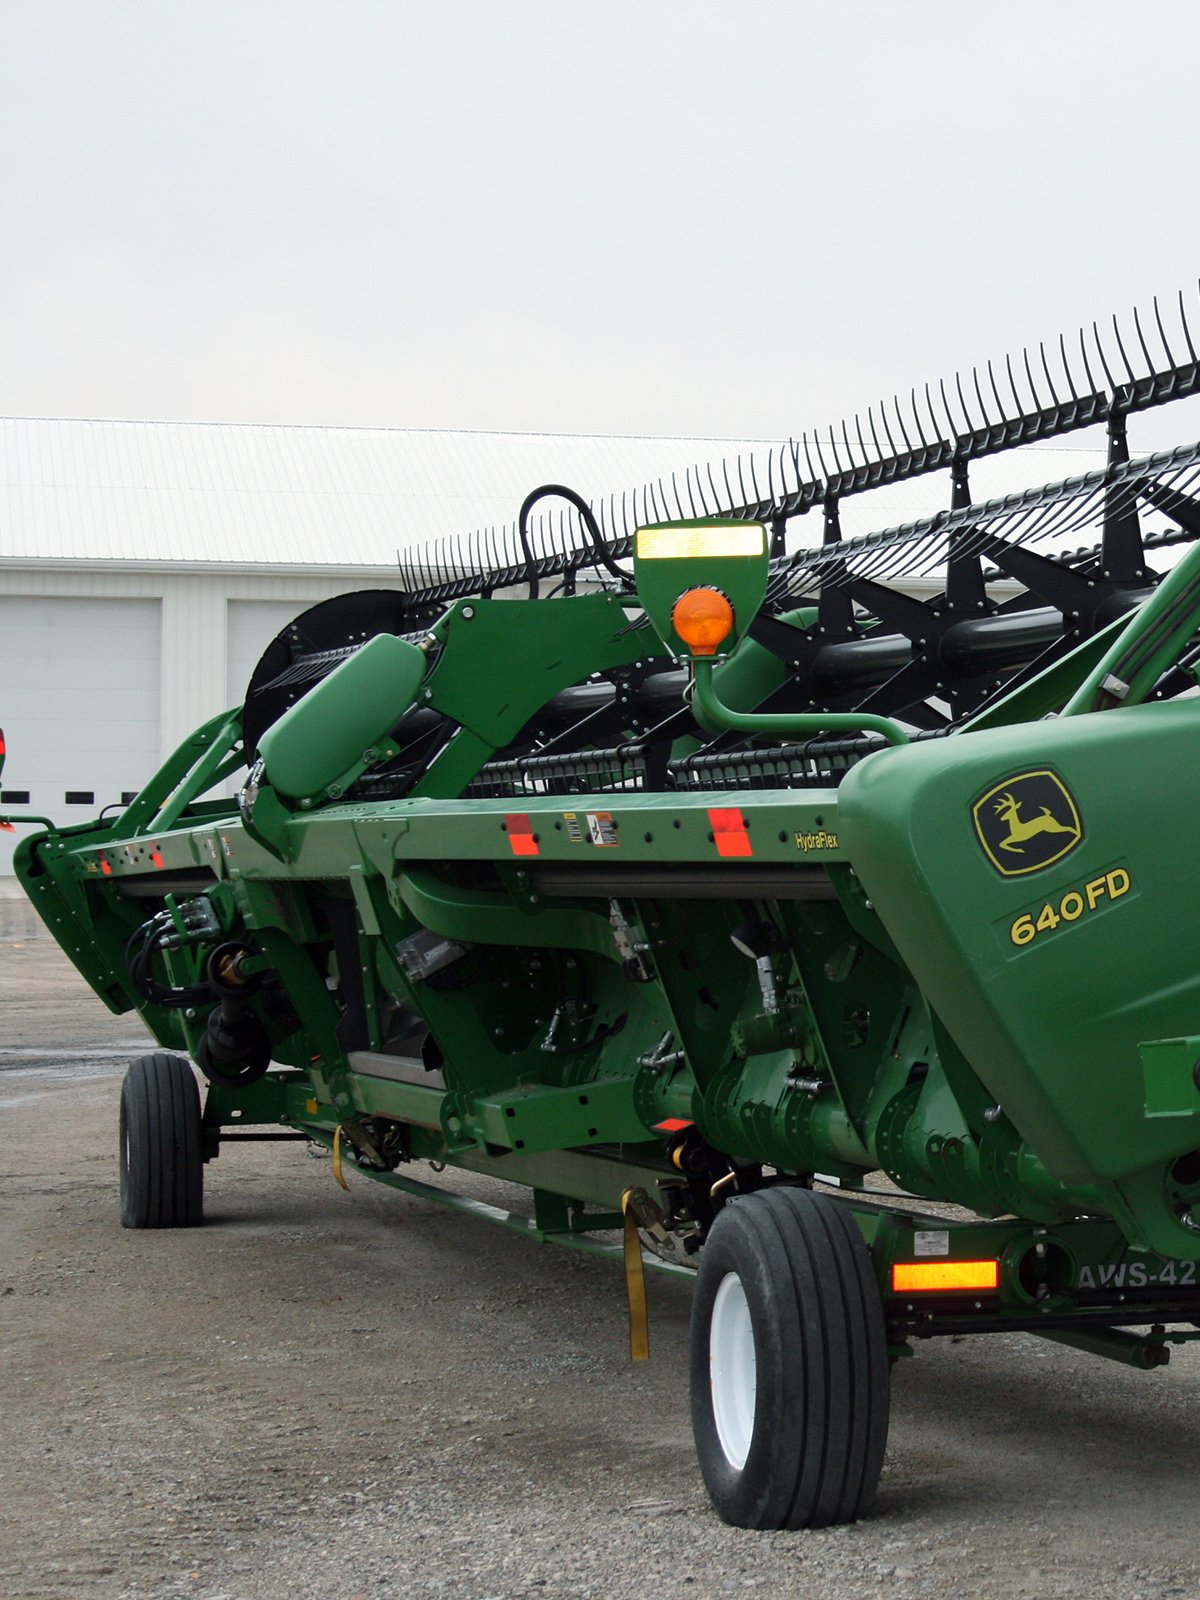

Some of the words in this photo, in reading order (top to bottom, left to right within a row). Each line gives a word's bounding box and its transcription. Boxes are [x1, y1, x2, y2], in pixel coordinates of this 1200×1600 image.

[794, 831, 839, 852] HydraFlex
[1010, 868, 1131, 946] 640FD
[1079, 1260, 1197, 1289] AWS-42
